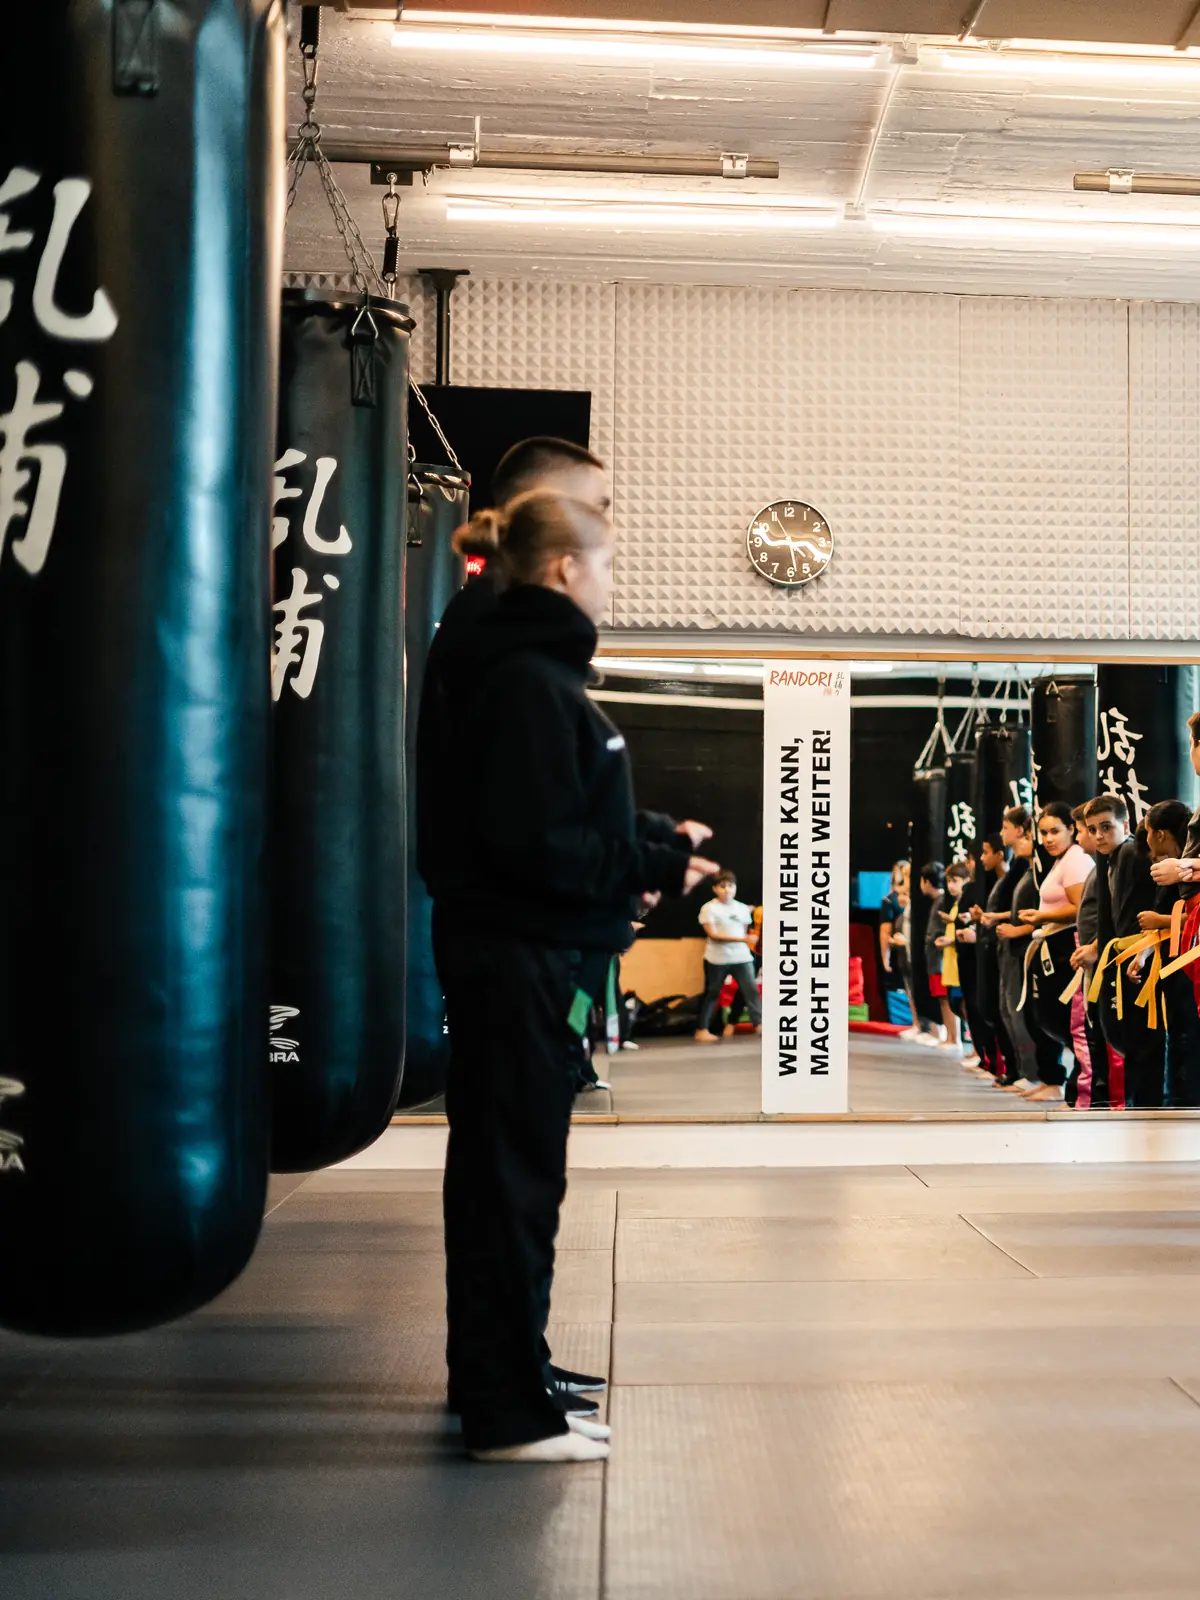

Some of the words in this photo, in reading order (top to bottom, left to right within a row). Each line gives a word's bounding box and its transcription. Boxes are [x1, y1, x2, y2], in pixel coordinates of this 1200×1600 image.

[771, 511, 778, 521] 11
[784, 507, 795, 517] 12
[812, 522, 820, 532] 2
[754, 537, 763, 547] 9
[818, 537, 826, 547] 3
[760, 552, 768, 562] 8
[771, 563, 779, 573] 7
[786, 567, 795, 577] 6
[802, 563, 810, 574] 5
[769, 670, 833, 687] RANDORI
[780, 738, 804, 823] KANN,
[811, 729, 831, 842] WEITER!
[780, 833, 799, 911] MEHR
[811, 852, 830, 969] EINFACH
[780, 921, 799, 1005] NICHT
[810, 978, 829, 1075] MACHT
[779, 1016, 798, 1076] WER
